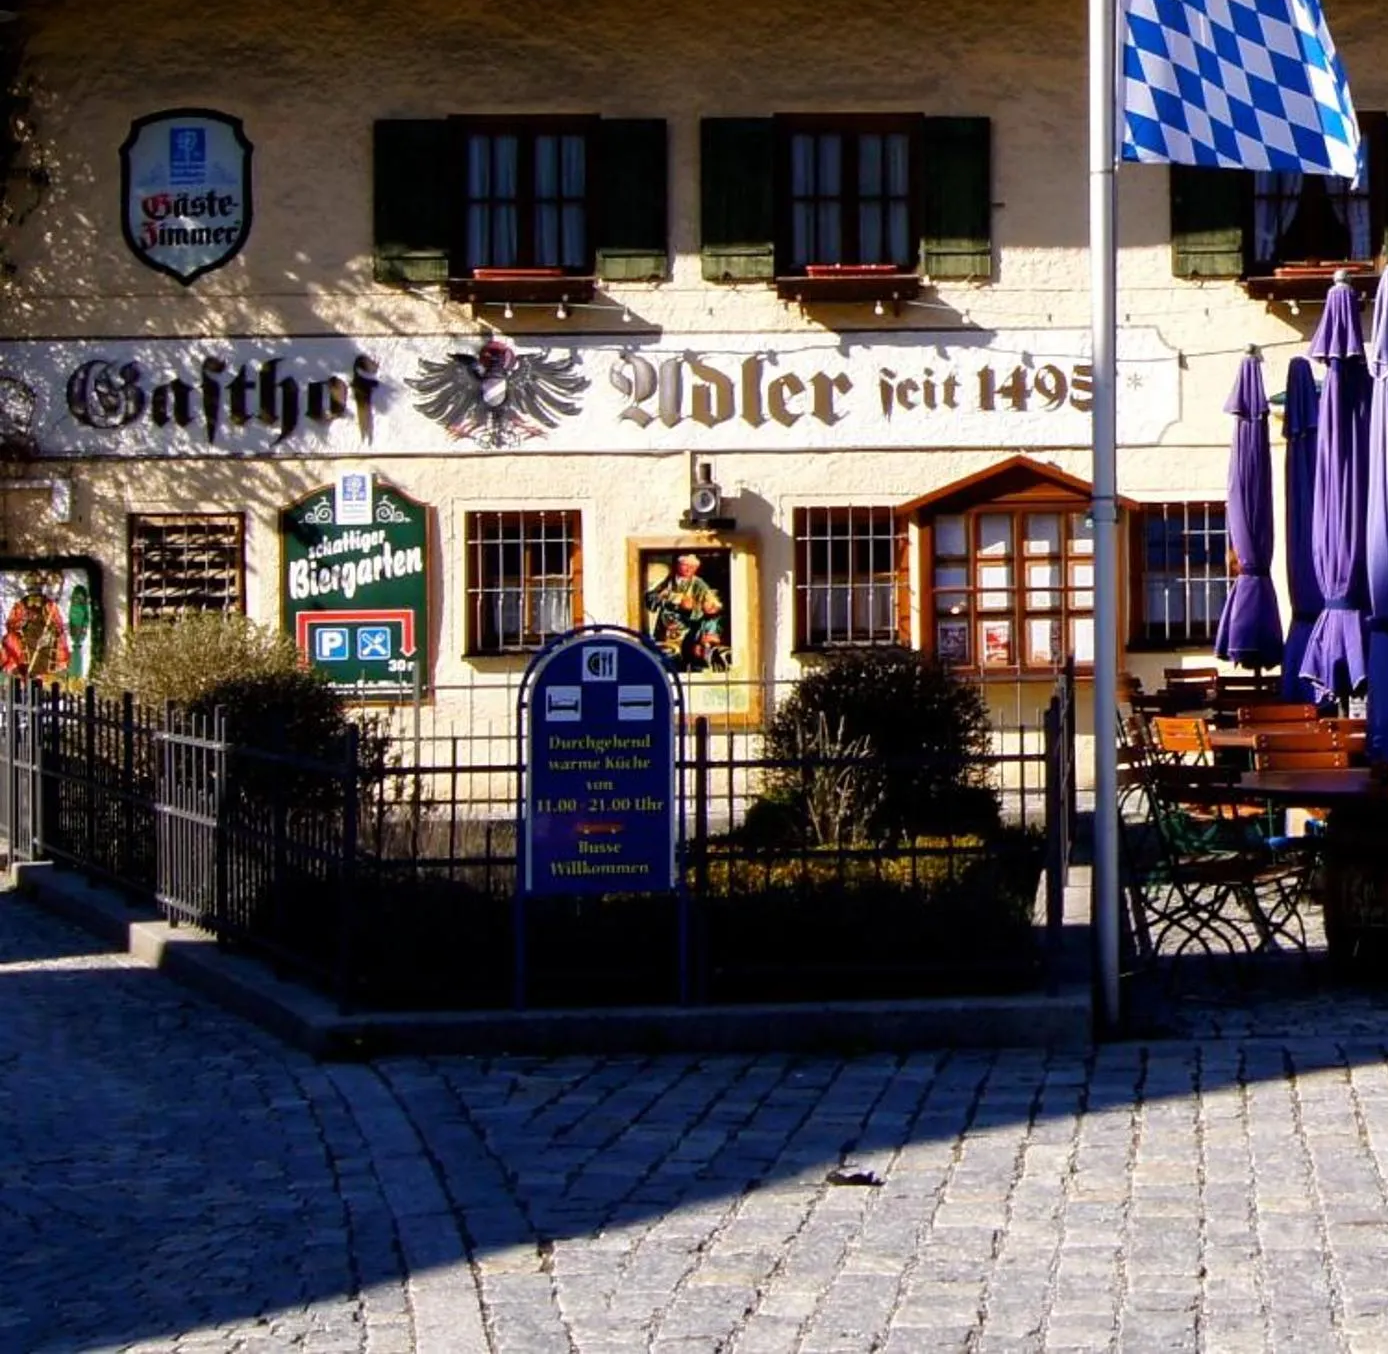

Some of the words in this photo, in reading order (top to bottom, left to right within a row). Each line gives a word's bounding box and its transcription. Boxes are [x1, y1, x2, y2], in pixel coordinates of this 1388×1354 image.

[139, 219, 239, 250] Zimmer
[609, 353, 854, 429] Adler
[879, 366, 961, 422] seit
[977, 362, 1093, 413] 1495
[308, 528, 387, 560] schattiger
[288, 542, 423, 600] Biergarten
[320, 630, 343, 658] P
[549, 734, 651, 755] Durchgehend
[548, 759, 601, 771] warme
[586, 780, 614, 791] von
[537, 798, 577, 812] 11.00
[588, 798, 631, 812] 21.00
[635, 796, 665, 811] Uhr
[550, 860, 650, 876] Willkommen
